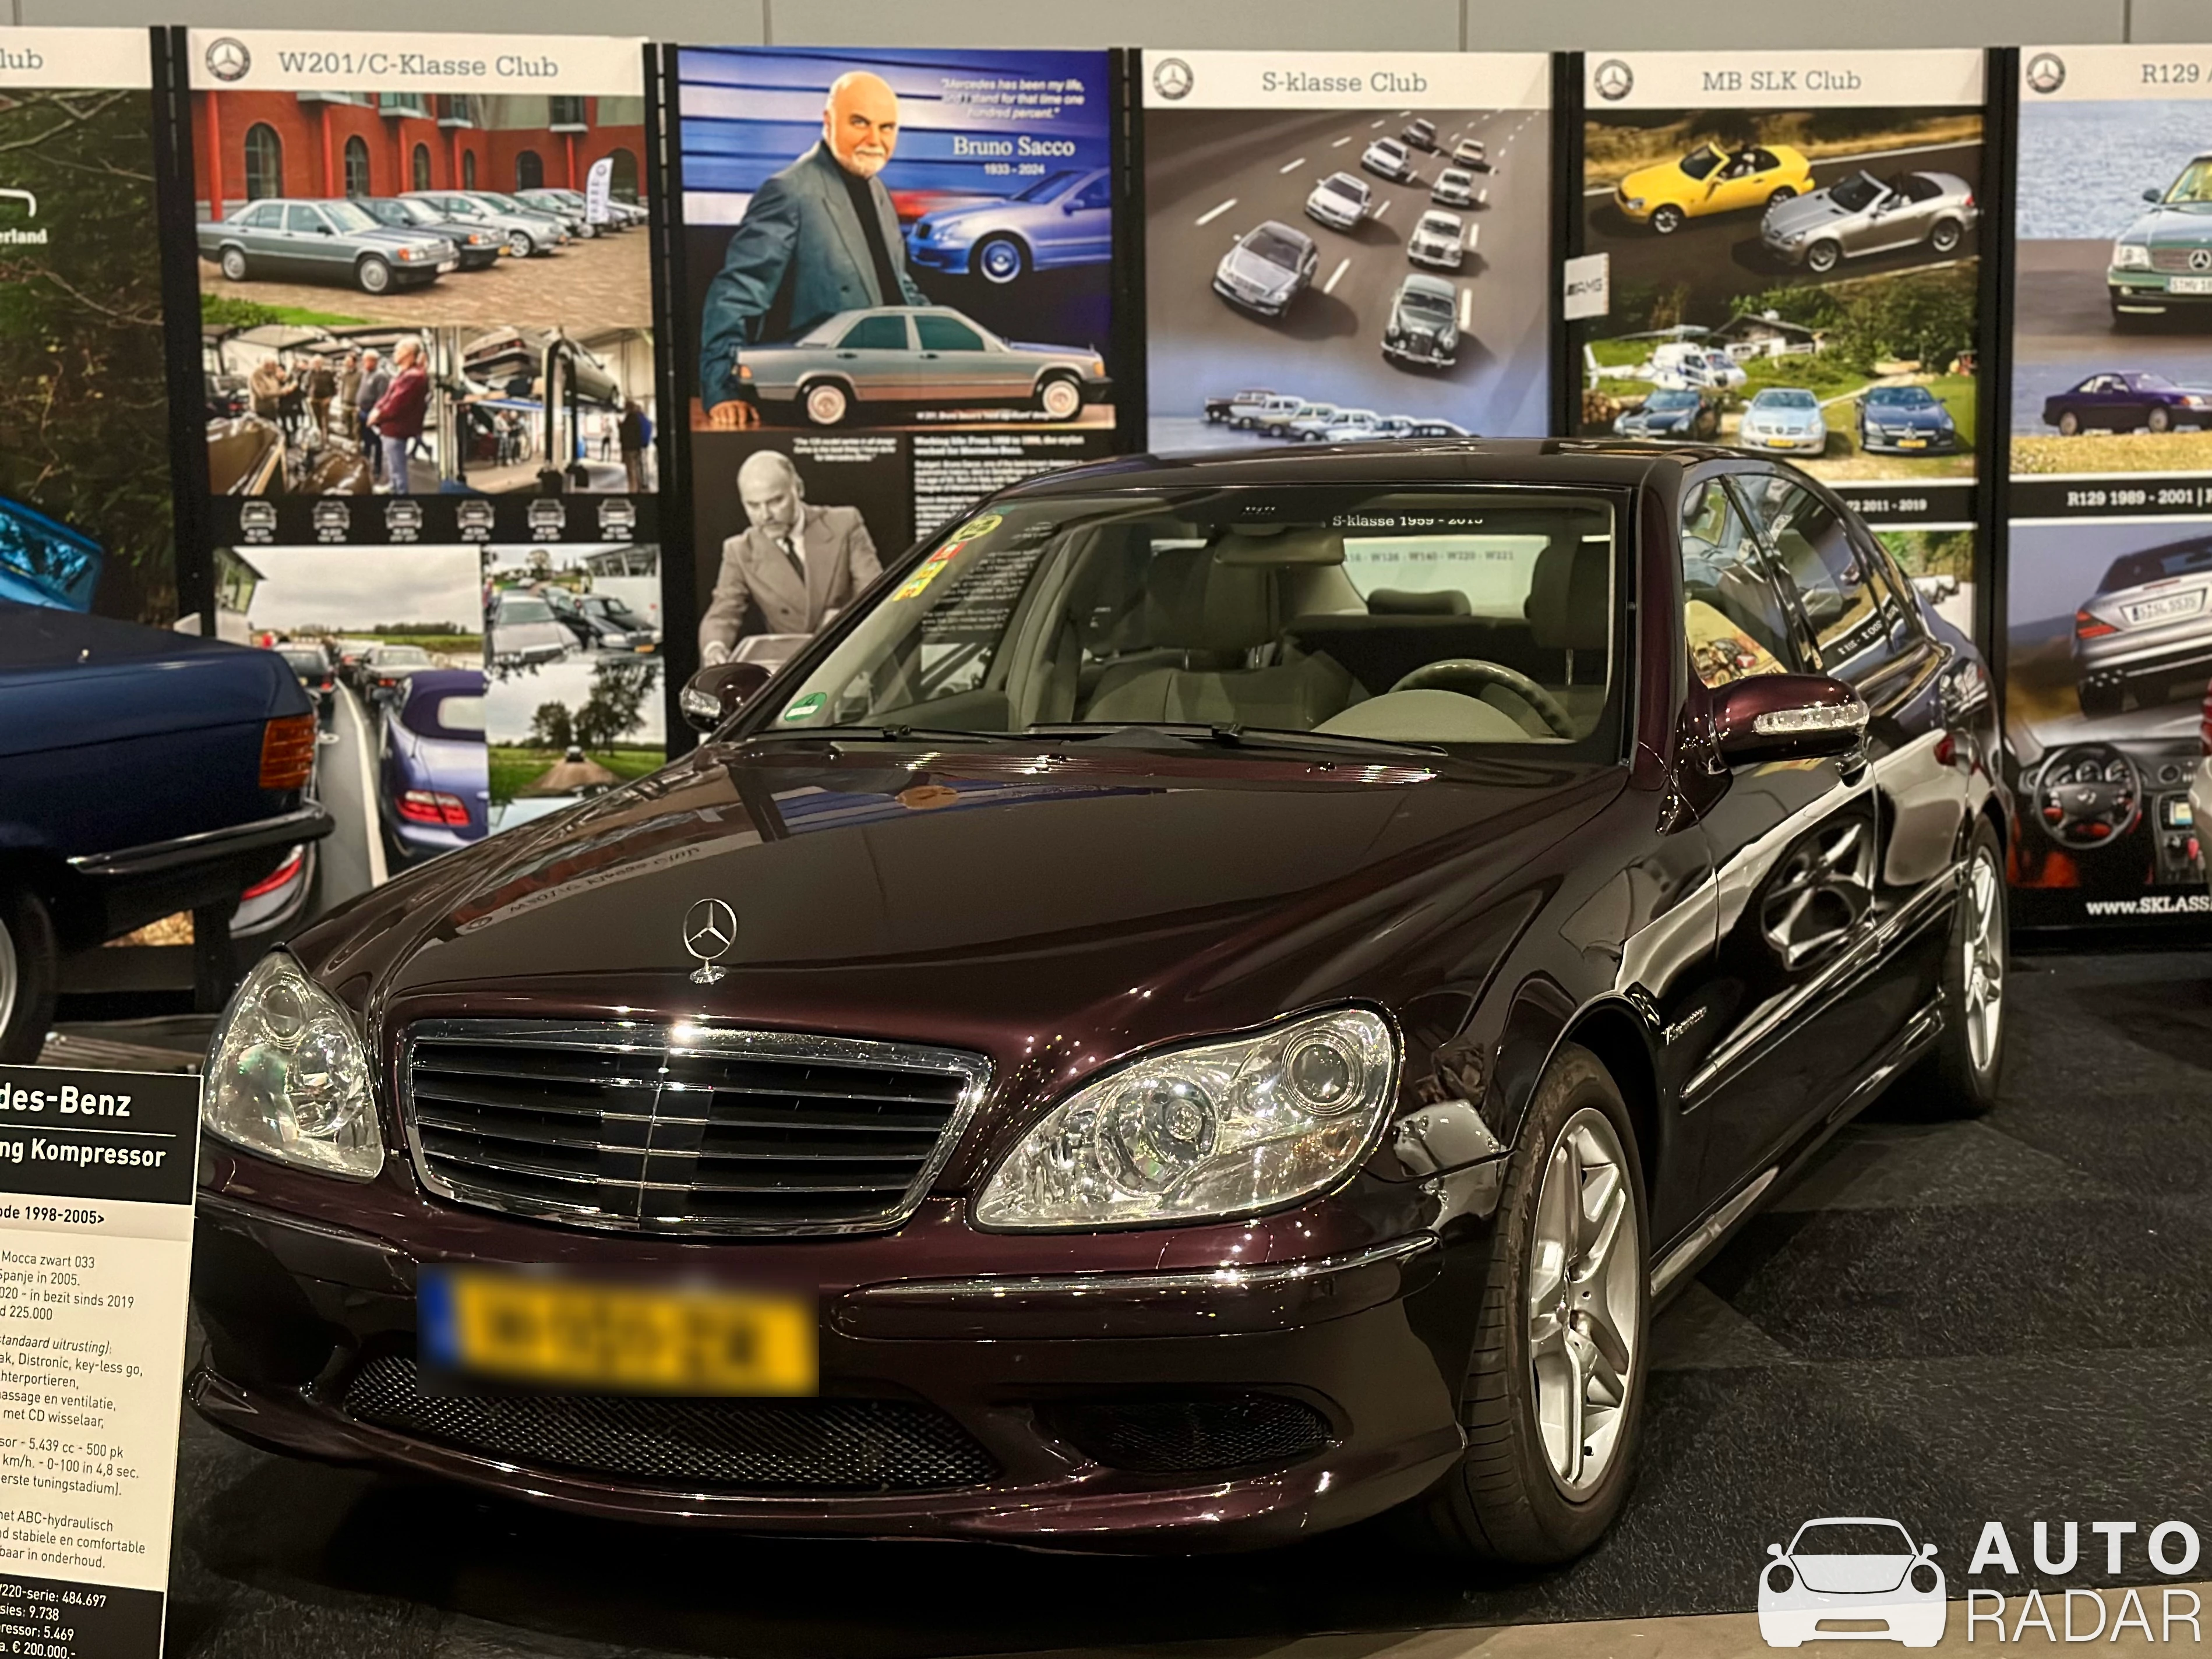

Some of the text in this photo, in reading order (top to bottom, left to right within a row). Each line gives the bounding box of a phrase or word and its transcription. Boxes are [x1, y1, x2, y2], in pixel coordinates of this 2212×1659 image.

[278, 51, 559, 77] W201/C-Klasse Club
[2141, 63, 2200, 83] R129
[997, 79, 1017, 91] has
[1019, 79, 1046, 91] been
[1262, 71, 1427, 92] S-klasse Club
[1703, 70, 1861, 91] MB SLK Club
[1001, 93, 1016, 105] for
[1064, 95, 1085, 105] one
[953, 136, 1076, 157] Bruno Sacco
[985, 163, 1011, 175] 1933
[1018, 163, 1046, 176] 2024
[1862, 498, 1890, 513] 2011
[2067, 490, 2107, 507] R129
[2109, 489, 2146, 506] 1989
[2158, 488, 2194, 505] 2001
[1333, 515, 1395, 526] S-klasse
[2086, 895, 2212, 915] www.SKLASS
[0, 1082, 132, 1117] des-Benz
[0, 1138, 167, 1167] ng Kompressor
[25, 1206, 105, 1224] 1998-2005>
[1, 1249, 95, 1269] Mocca zwart 033
[37, 1270, 47, 1284] in
[51, 1272, 80, 1286] 2005.
[30, 1289, 40, 1302] in
[44, 1290, 70, 1304] bezit
[73, 1293, 104, 1307] sinds
[107, 1294, 135, 1309] 2019
[9, 1305, 53, 1321] 225.000
[18, 1353, 72, 1371] Distronic,
[75, 1358, 123, 1374] key-less
[126, 1365, 143, 1378] go,
[0, 1390, 117, 1412] assage en ventilatie,
[3, 1409, 104, 1429] met CD wisselaar,
[29, 1437, 59, 1452] 5.439
[62, 1443, 75, 1454] cc
[86, 1442, 107, 1457] 500
[110, 1445, 124, 1460] pk
[2, 1453, 35, 1469] km/h.
[47, 1457, 80, 1473] 0-100
[83, 1461, 93, 1474] in
[96, 1463, 113, 1477] 4,8
[116, 1467, 139, 1479] sec.
[1, 1474, 30, 1486] erste
[17, 1510, 114, 1532] ABC-hydraulisch
[12, 1529, 57, 1545] stabiele
[59, 1536, 73, 1547] en
[76, 1537, 146, 1554] comfortable
[27, 1547, 38, 1561] in
[41, 1551, 105, 1569] onderhoud.
[0, 1583, 107, 1608] 220-serie: 484.697
[0, 1602, 60, 1622] sies: 9.738
[44, 1625, 75, 1642] 5.469
[12, 1640, 21, 1653] €
